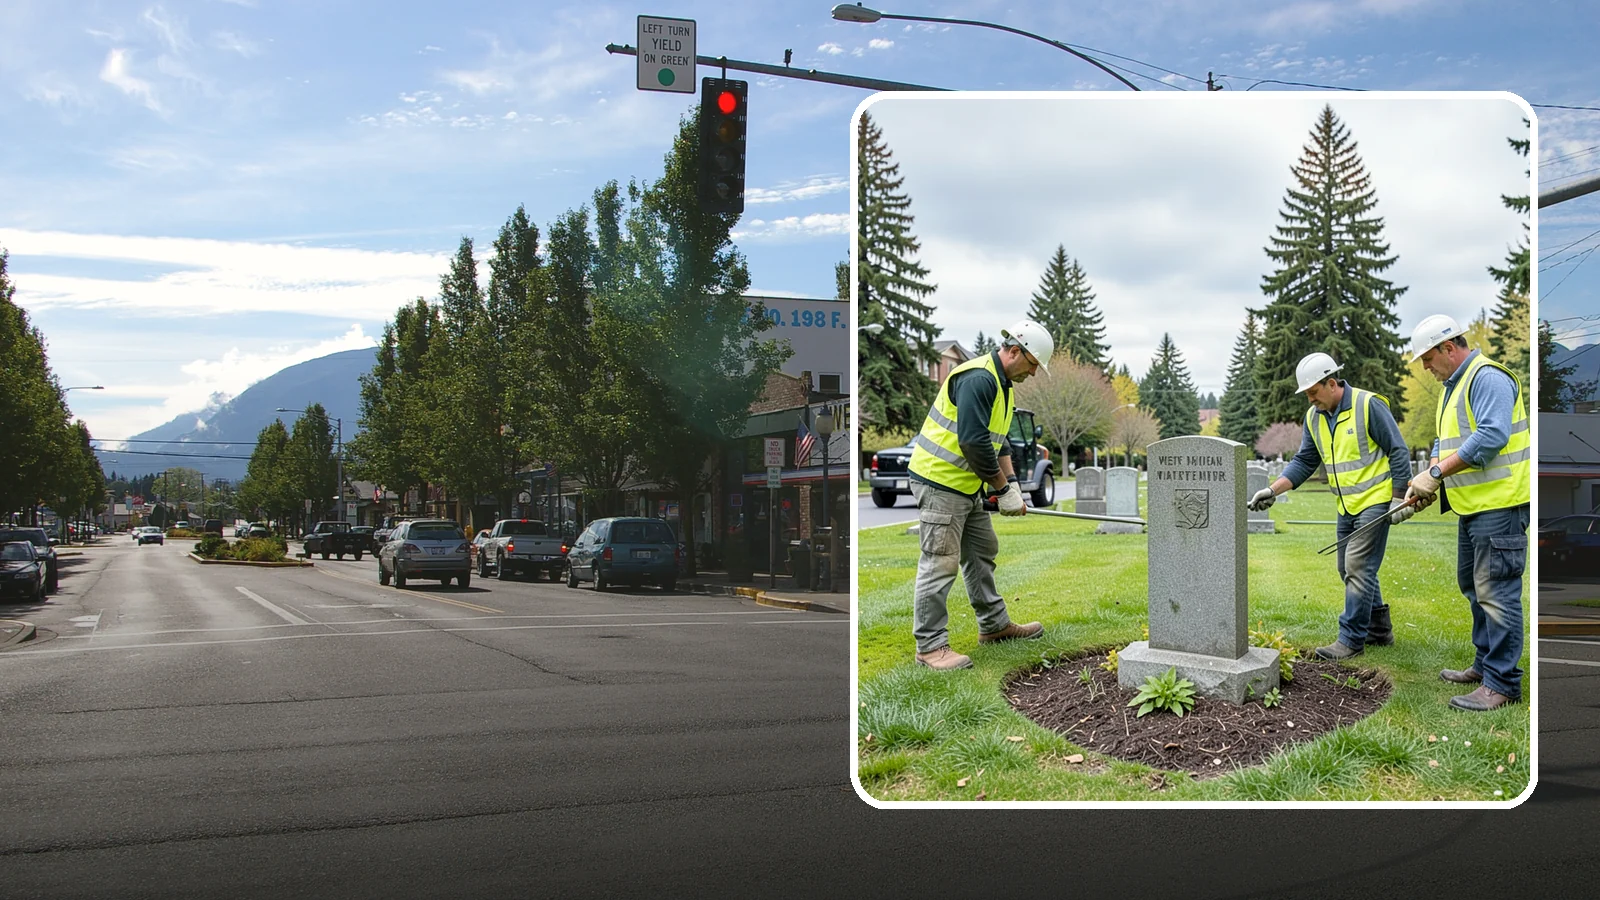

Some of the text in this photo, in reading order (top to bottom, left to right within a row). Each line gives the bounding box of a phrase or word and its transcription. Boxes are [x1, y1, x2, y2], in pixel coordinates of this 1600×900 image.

[643, 24, 690, 36] LEFT TURN
[652, 38, 682, 51] YIELD
[644, 53, 689, 66] ON GREEN
[791, 309, 826, 328] 198
[831, 311, 847, 329] F.
